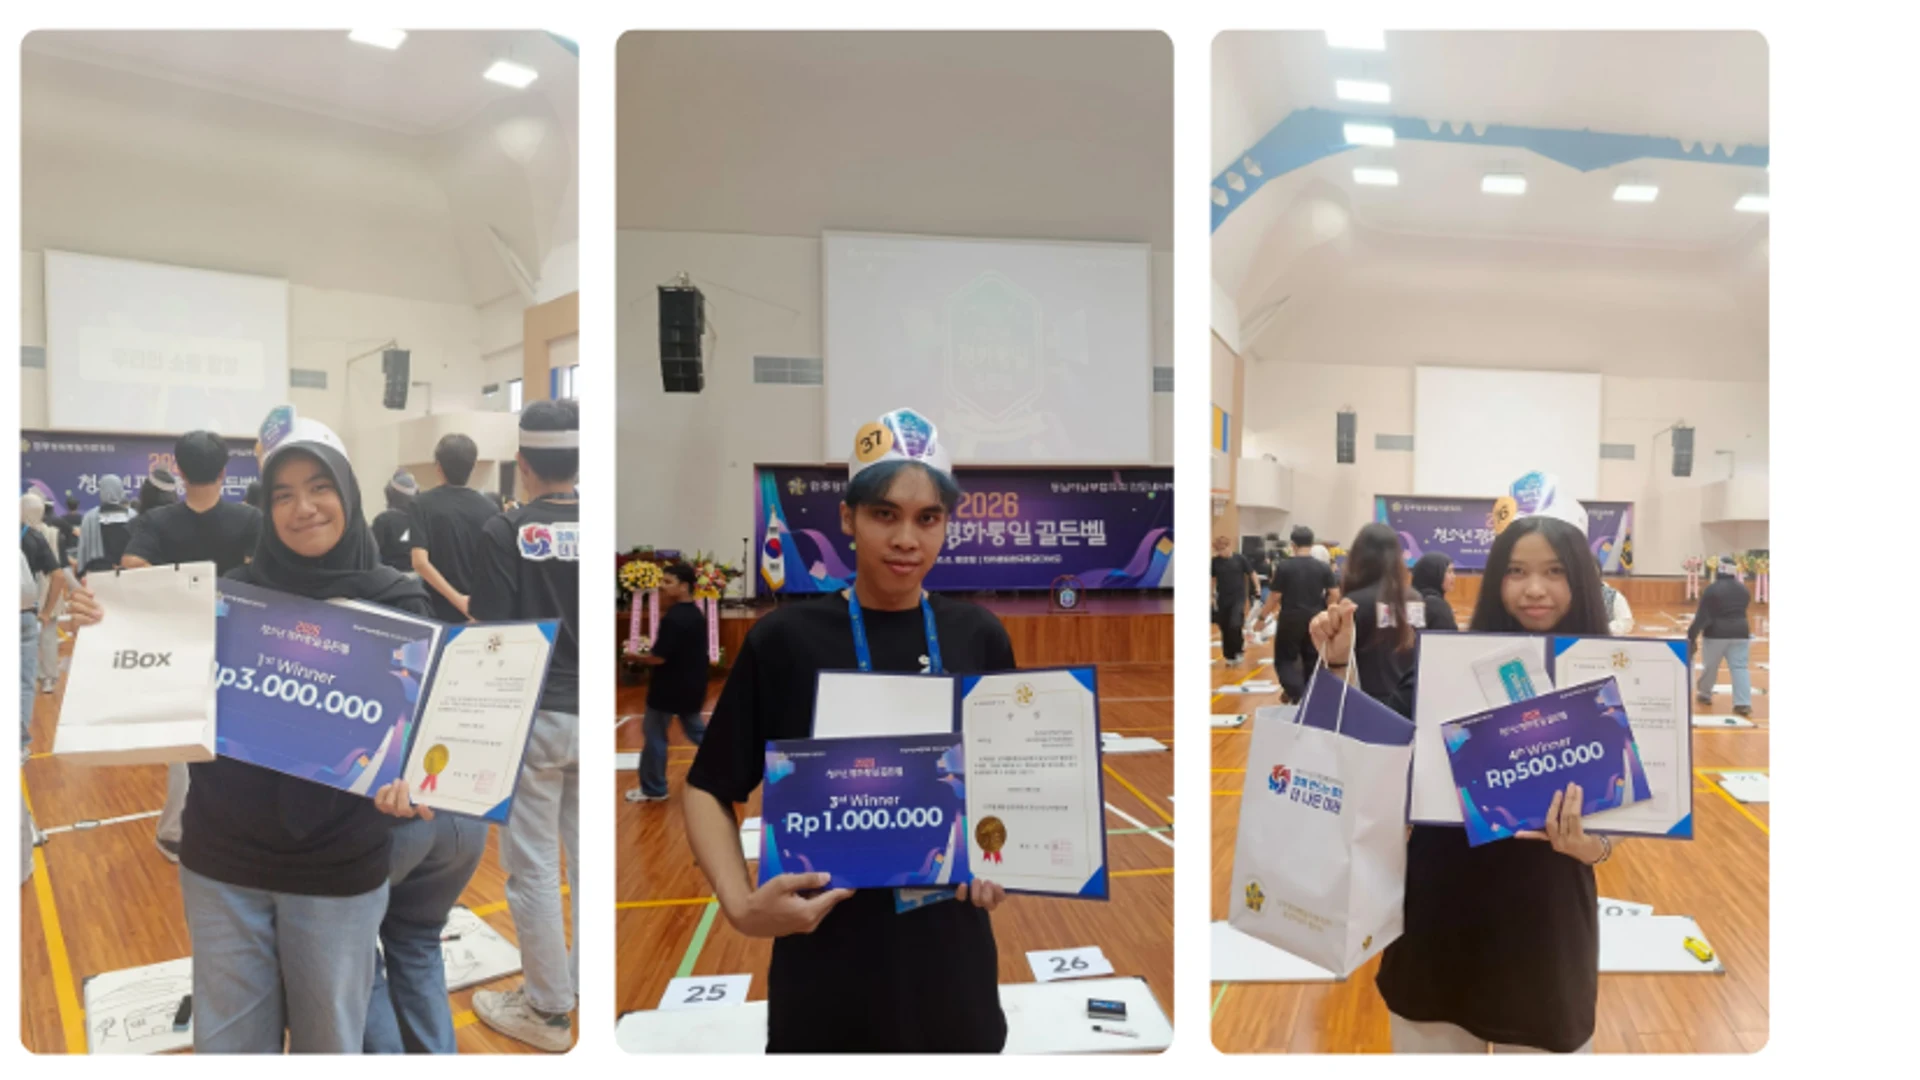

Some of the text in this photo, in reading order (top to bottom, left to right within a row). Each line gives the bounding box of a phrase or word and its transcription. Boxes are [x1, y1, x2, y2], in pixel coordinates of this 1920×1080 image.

[860, 429, 882, 454] 37
[956, 491, 1019, 519] 2026
[1035, 519, 1107, 546] 골든벨
[112, 649, 173, 670] iBox
[277, 658, 337, 686] Winner
[1526, 736, 1572, 758] Winner
[1485, 741, 1605, 789] Rp500.000
[850, 793, 901, 808] Winner
[786, 806, 943, 839] Rp1.000.000
[1049, 955, 1090, 973] 26
[684, 983, 728, 1003] 25
